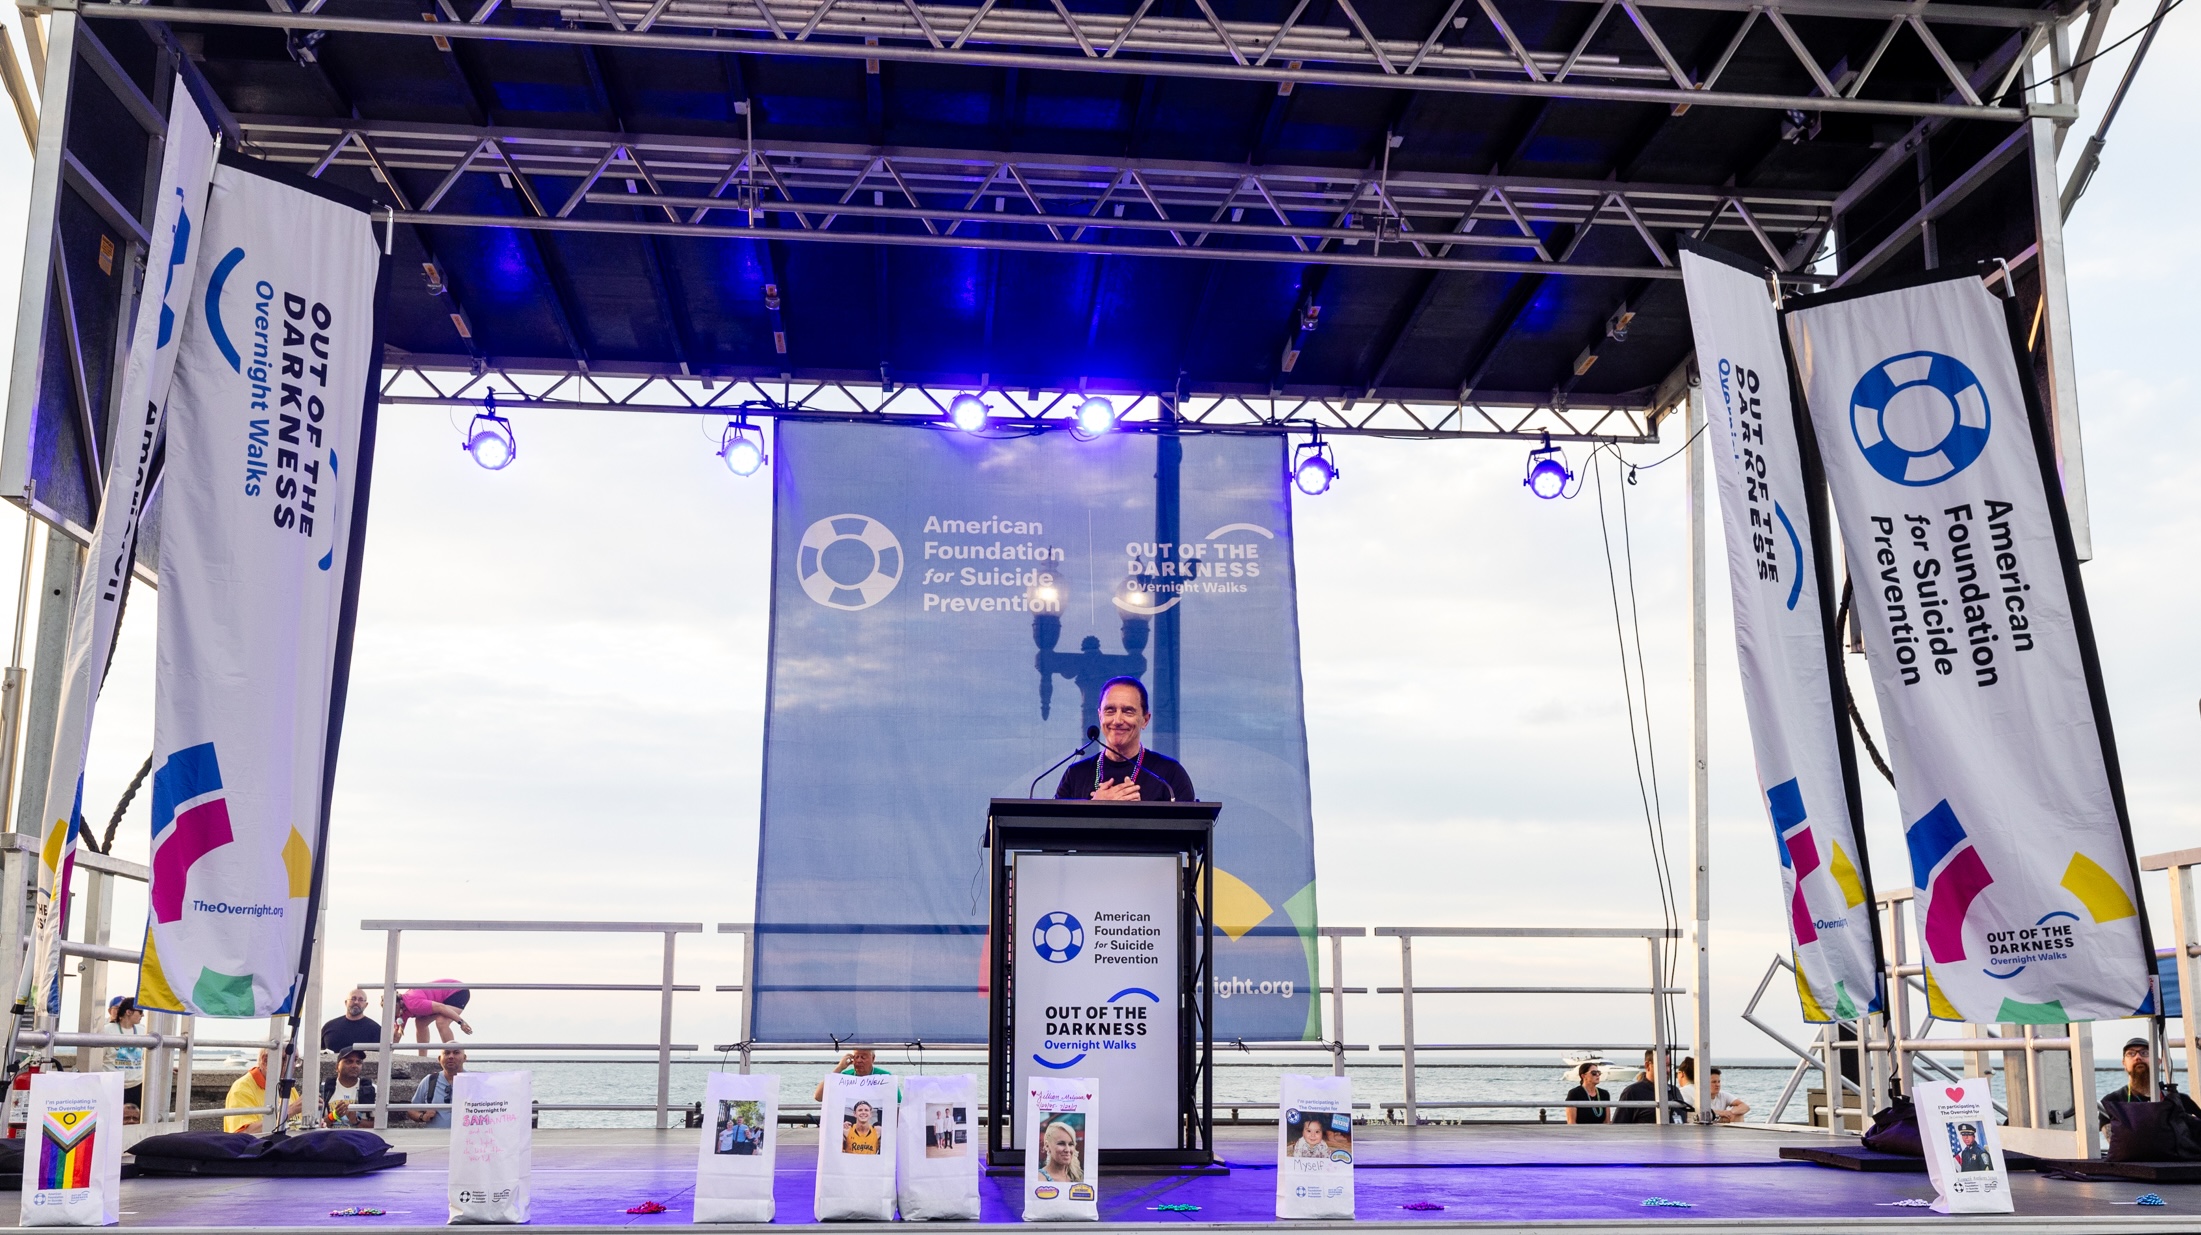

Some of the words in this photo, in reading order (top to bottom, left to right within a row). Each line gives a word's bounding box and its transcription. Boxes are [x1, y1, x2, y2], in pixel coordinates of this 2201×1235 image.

[246, 280, 275, 411] Overnight
[308, 301, 332, 388] OUT
[273, 291, 307, 529] DARKNESS
[1747, 369, 1764, 446] OUT
[306, 394, 327, 448] OF
[244, 418, 271, 498] Walks
[1735, 364, 1769, 582] DARKNESS
[1755, 454, 1770, 502] OF
[299, 460, 319, 538] THE
[923, 515, 1043, 535] American
[1904, 513, 1931, 553] for
[924, 541, 1065, 561] Foundation
[1125, 542, 1173, 560] OUT
[1178, 542, 1208, 560] OF
[1214, 542, 1259, 560] THE
[1762, 513, 1780, 584] THE
[922, 568, 955, 586] for
[960, 566, 1054, 587] Suicide
[1127, 560, 1261, 578] DARKNESS
[1984, 499, 2035, 652] American
[1126, 580, 1200, 596] Overnight
[1203, 580, 1248, 593] Walks
[1944, 503, 1999, 688] Foundation
[923, 593, 1061, 612] Prevention
[1870, 515, 1922, 687] Prevention
[1912, 558, 1954, 676] Suicide
[193, 900, 284, 918] TheOvernight.org
[1094, 911, 1151, 922] American
[1094, 925, 1161, 937] Foundation
[1986, 930, 2016, 944] OUT
[2020, 928, 2039, 941] OF
[2041, 925, 2072, 938] THE
[1094, 940, 1108, 950] for
[1110, 939, 1154, 951] Suicide
[1989, 936, 2075, 955] DARKNESS
[1094, 954, 1159, 965] Prevention
[1990, 955, 2037, 966] Overnight
[2038, 952, 2068, 962] Walks
[1045, 1006, 1082, 1020] OUT
[1085, 1006, 1109, 1020] OF
[1112, 1006, 1147, 1020] THE
[1046, 1022, 1148, 1036] DARKNESS
[1044, 1039, 1101, 1052] Overnight
[1102, 1039, 1137, 1050] Walks
[1293, 1159, 1325, 1172] Myself
